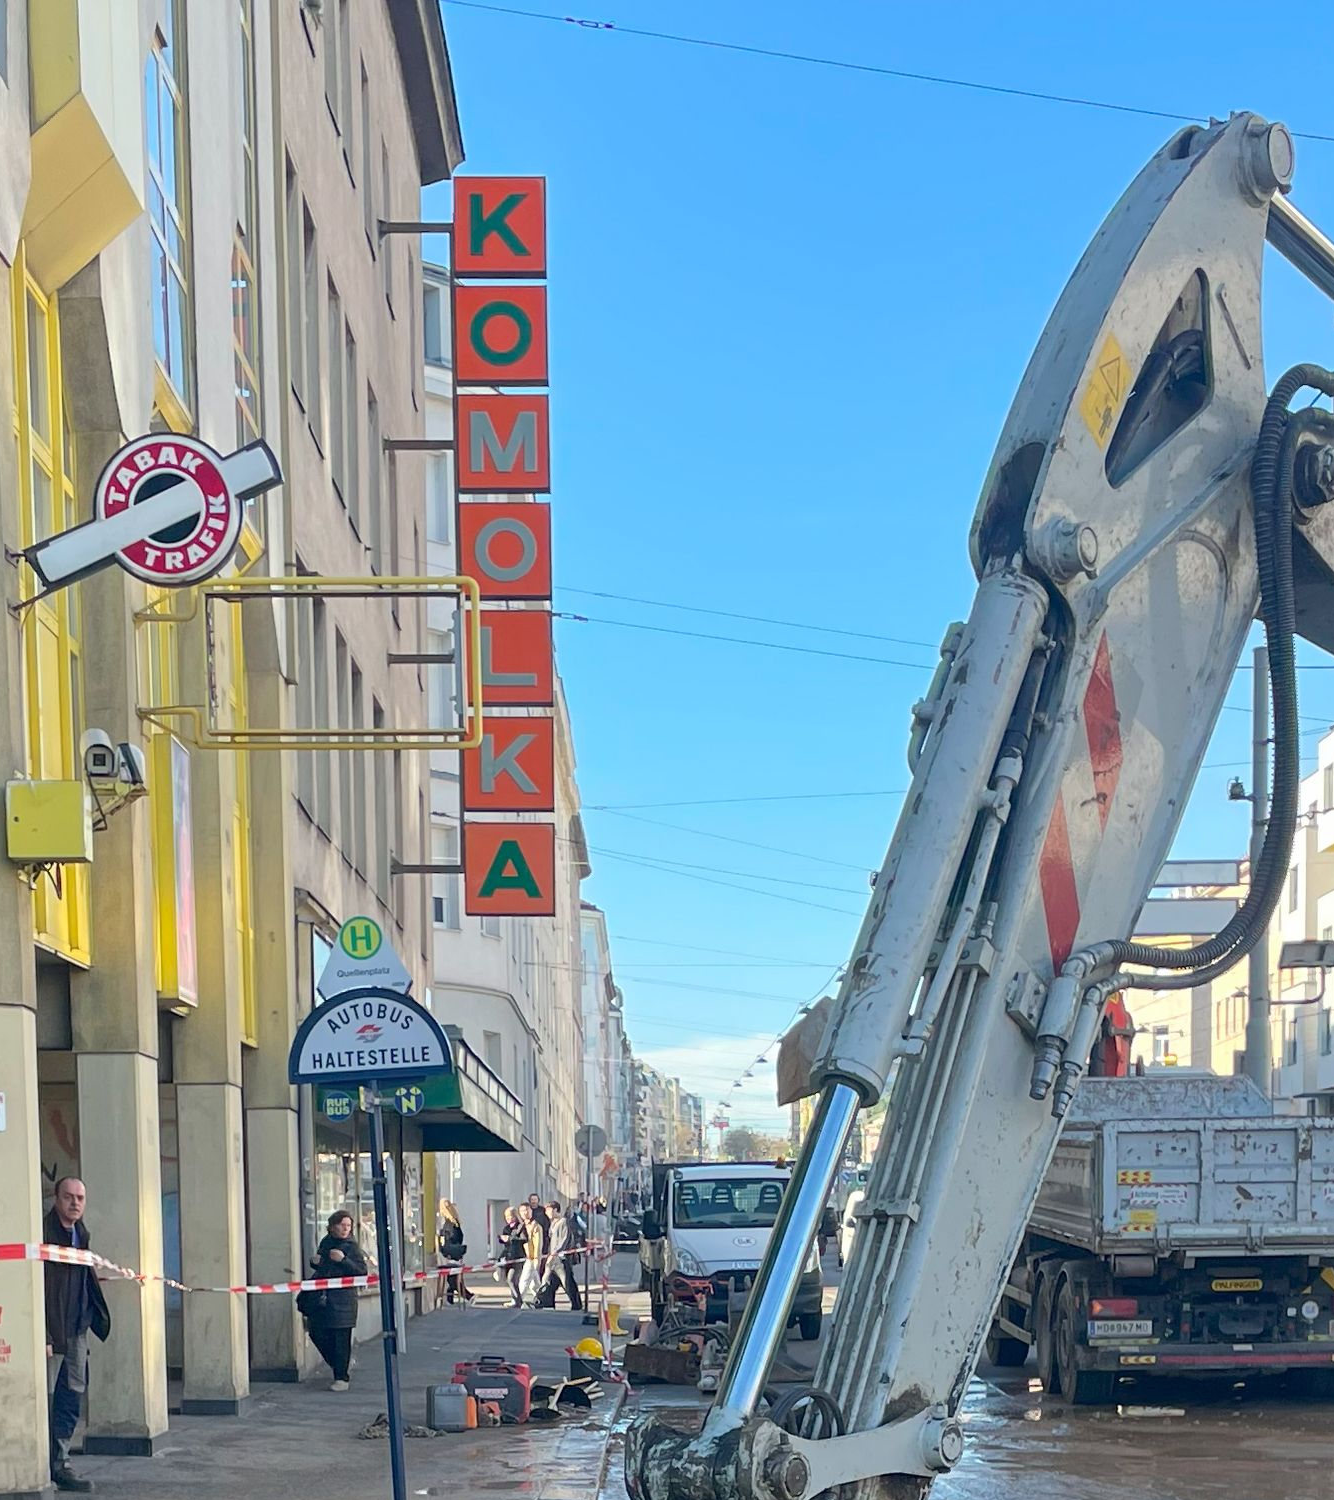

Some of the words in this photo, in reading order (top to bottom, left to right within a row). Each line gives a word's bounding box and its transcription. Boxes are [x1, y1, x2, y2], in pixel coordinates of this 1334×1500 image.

[106, 446, 203, 506] TABAK
[143, 492, 229, 574] TRAFIK
[469, 192, 543, 900] KOMOLKA
[350, 924, 372, 952] H
[336, 966, 390, 978] Quellenplatz
[326, 1002, 415, 1035] AUTOBUS
[311, 1045, 431, 1070] HALTESTELLE
[326, 1097, 351, 1107] RUF
[326, 1106, 351, 1116] BUS
[1214, 1280, 1260, 1290] PALFINGER
